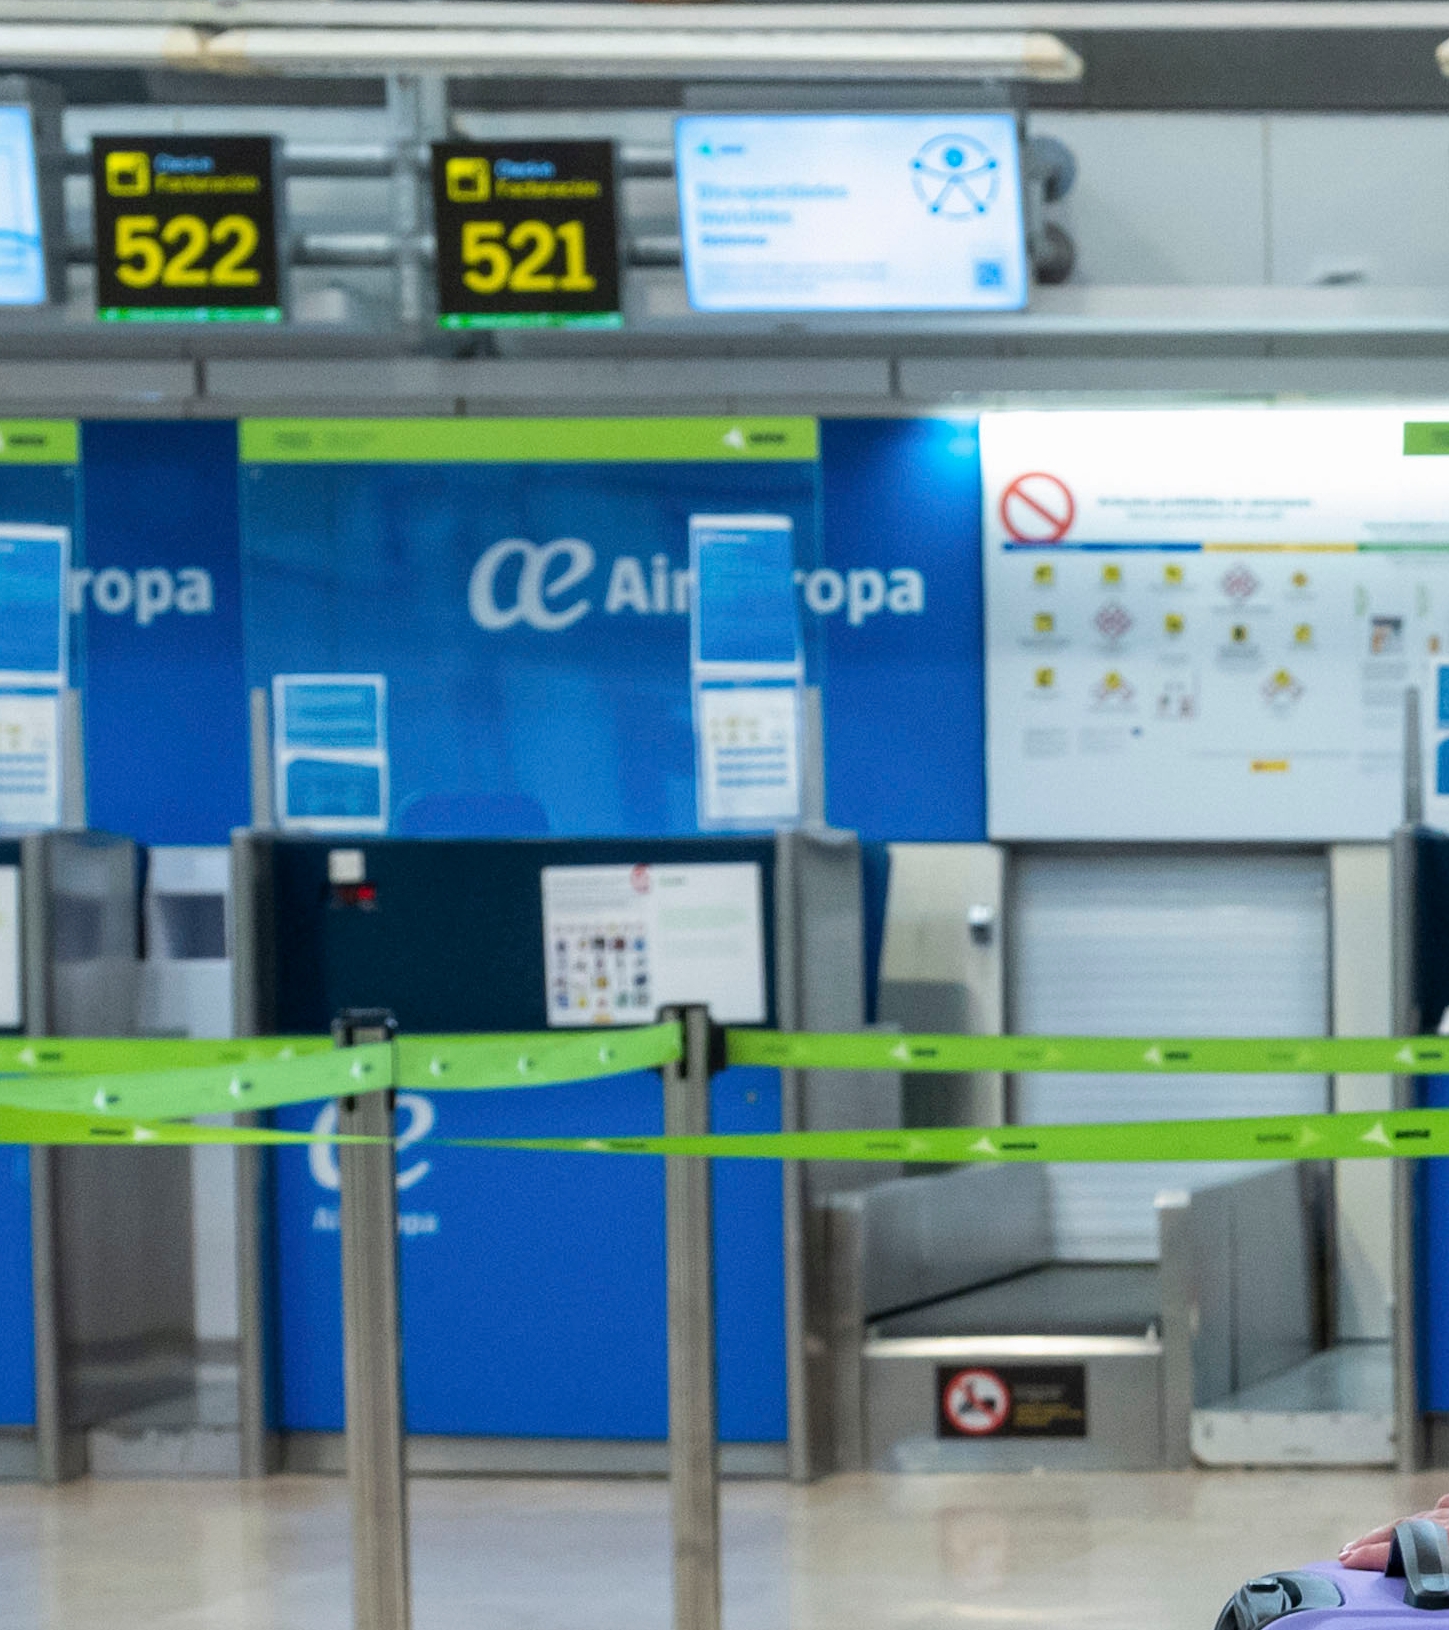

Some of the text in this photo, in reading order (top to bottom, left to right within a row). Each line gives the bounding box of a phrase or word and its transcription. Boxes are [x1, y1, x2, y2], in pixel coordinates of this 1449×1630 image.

[115, 214, 260, 289] 522
[462, 219, 597, 295] 521
[67, 567, 214, 626] ropa
